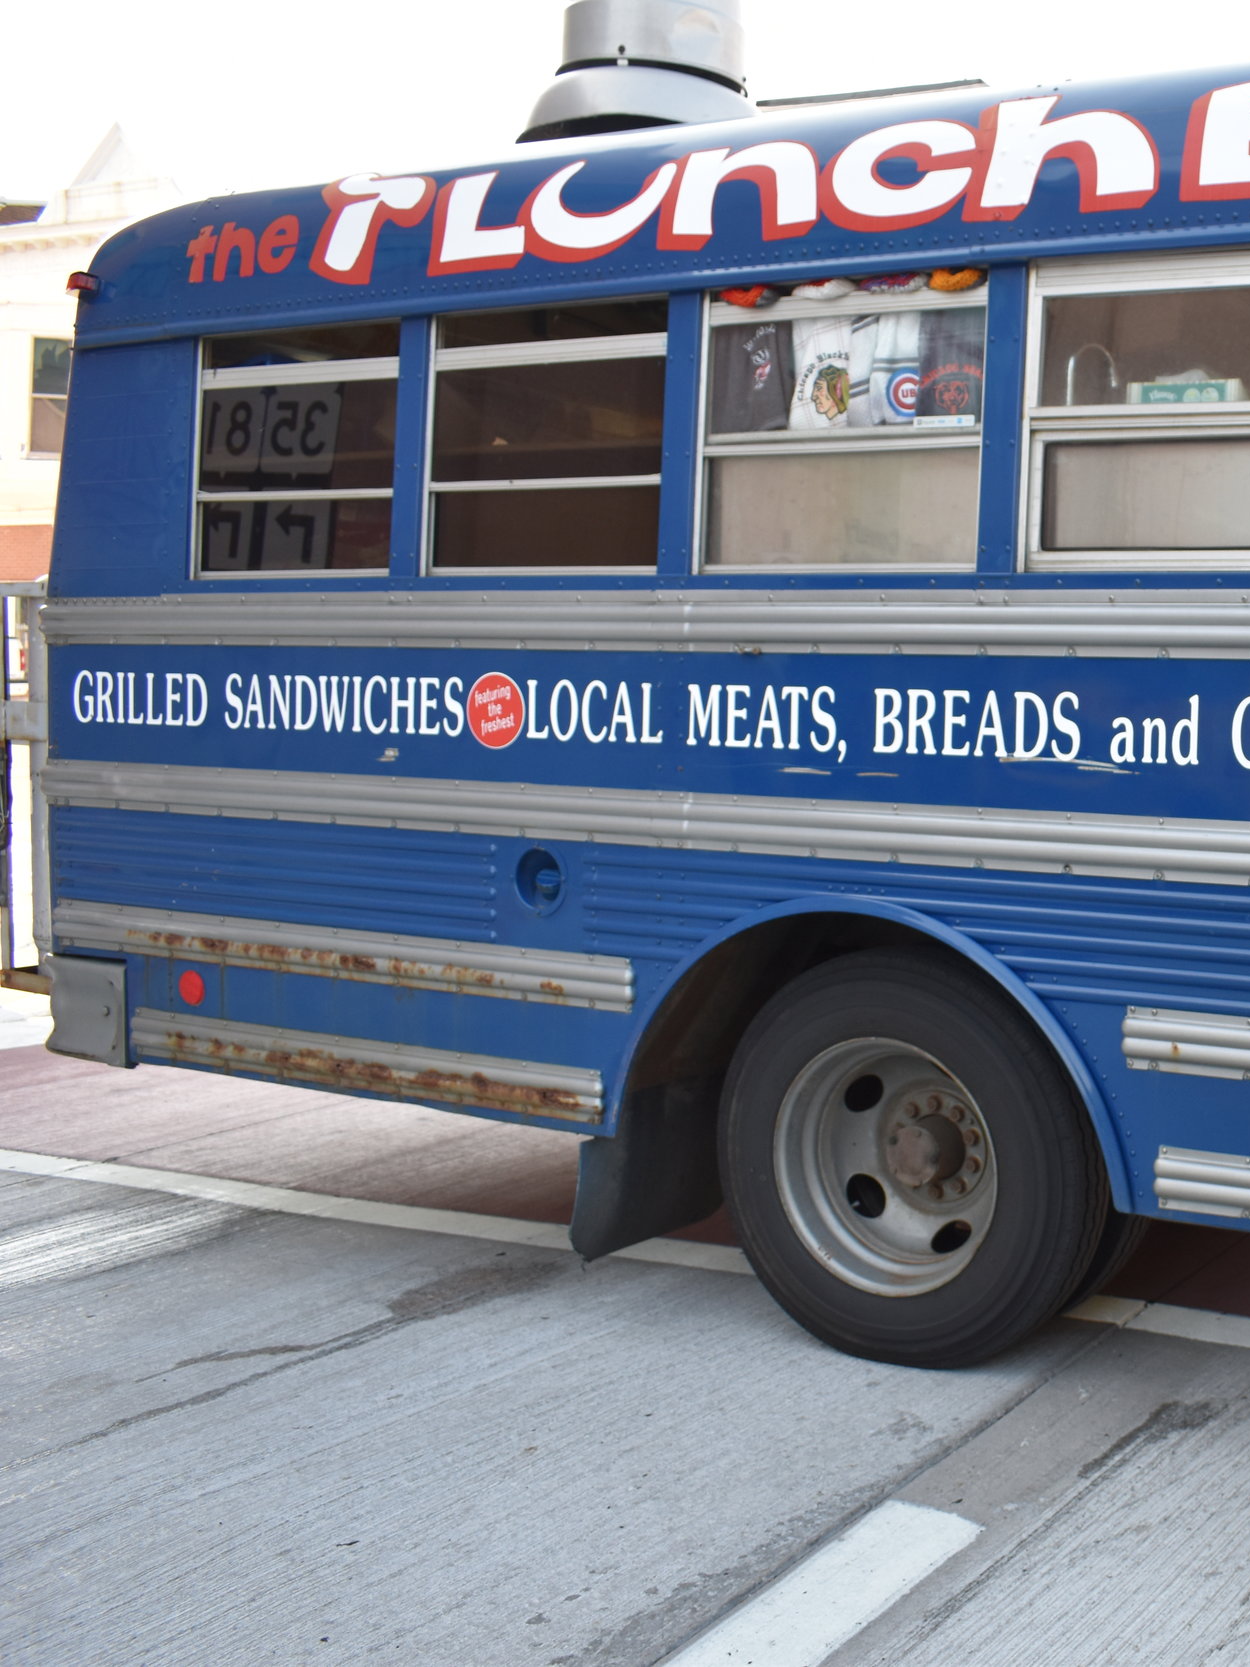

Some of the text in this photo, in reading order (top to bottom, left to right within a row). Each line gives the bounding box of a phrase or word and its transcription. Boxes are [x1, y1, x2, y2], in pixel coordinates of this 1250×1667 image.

[187, 215, 299, 284] the
[73, 669, 465, 738] GRILLED SANDWICHES
[475, 685, 511, 708] featuring
[488, 703, 503, 717] the
[481, 713, 515, 736] freshest
[526, 679, 663, 744] LOCAL
[686, 684, 847, 764] MEATS,
[873, 687, 1081, 762] BREADS
[1110, 694, 1200, 766] and
